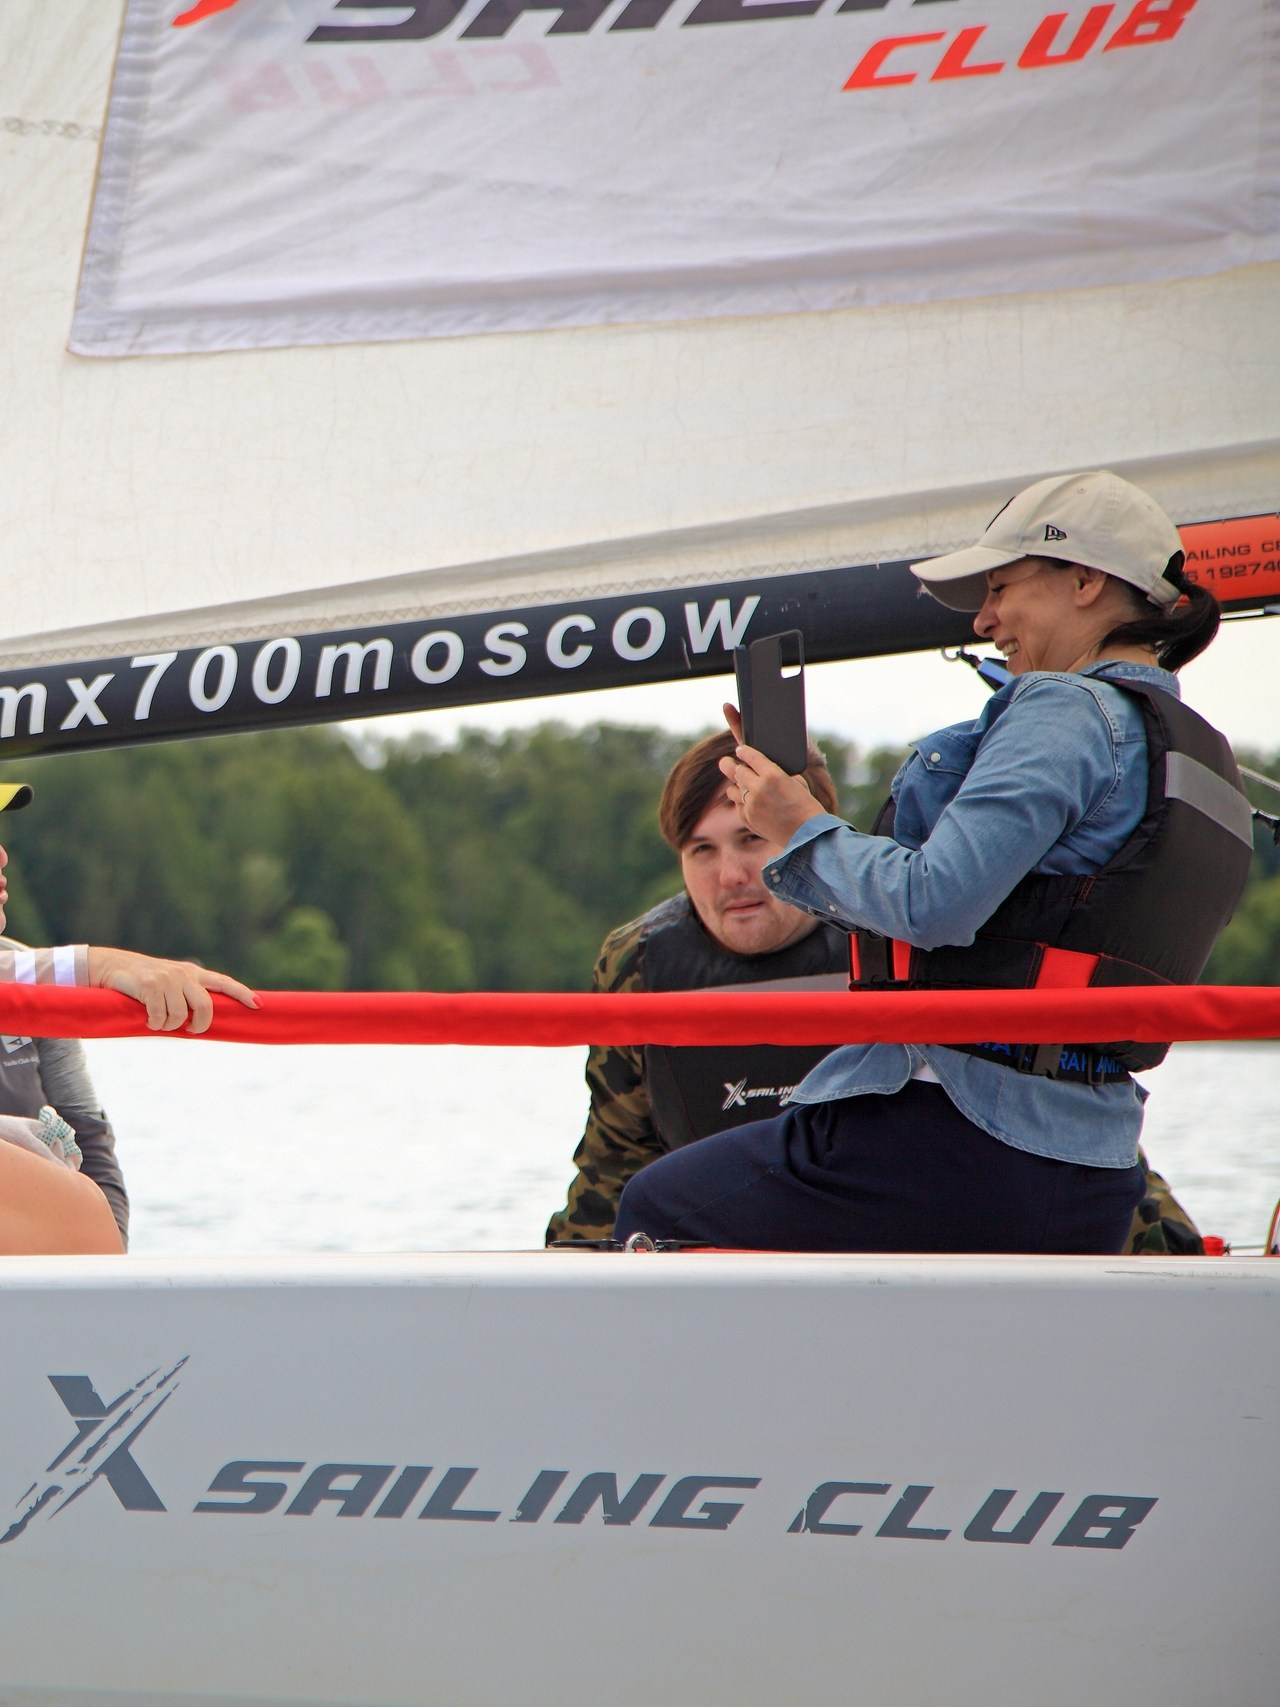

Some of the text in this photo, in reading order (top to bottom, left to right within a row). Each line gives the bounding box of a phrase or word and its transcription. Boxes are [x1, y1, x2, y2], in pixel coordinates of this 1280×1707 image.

[840, 0, 1198, 92] CLUB
[1186, 544, 1251, 562] AILING
[192, 1460, 762, 1531] SAILING
[786, 1481, 1159, 1550] CLUB
